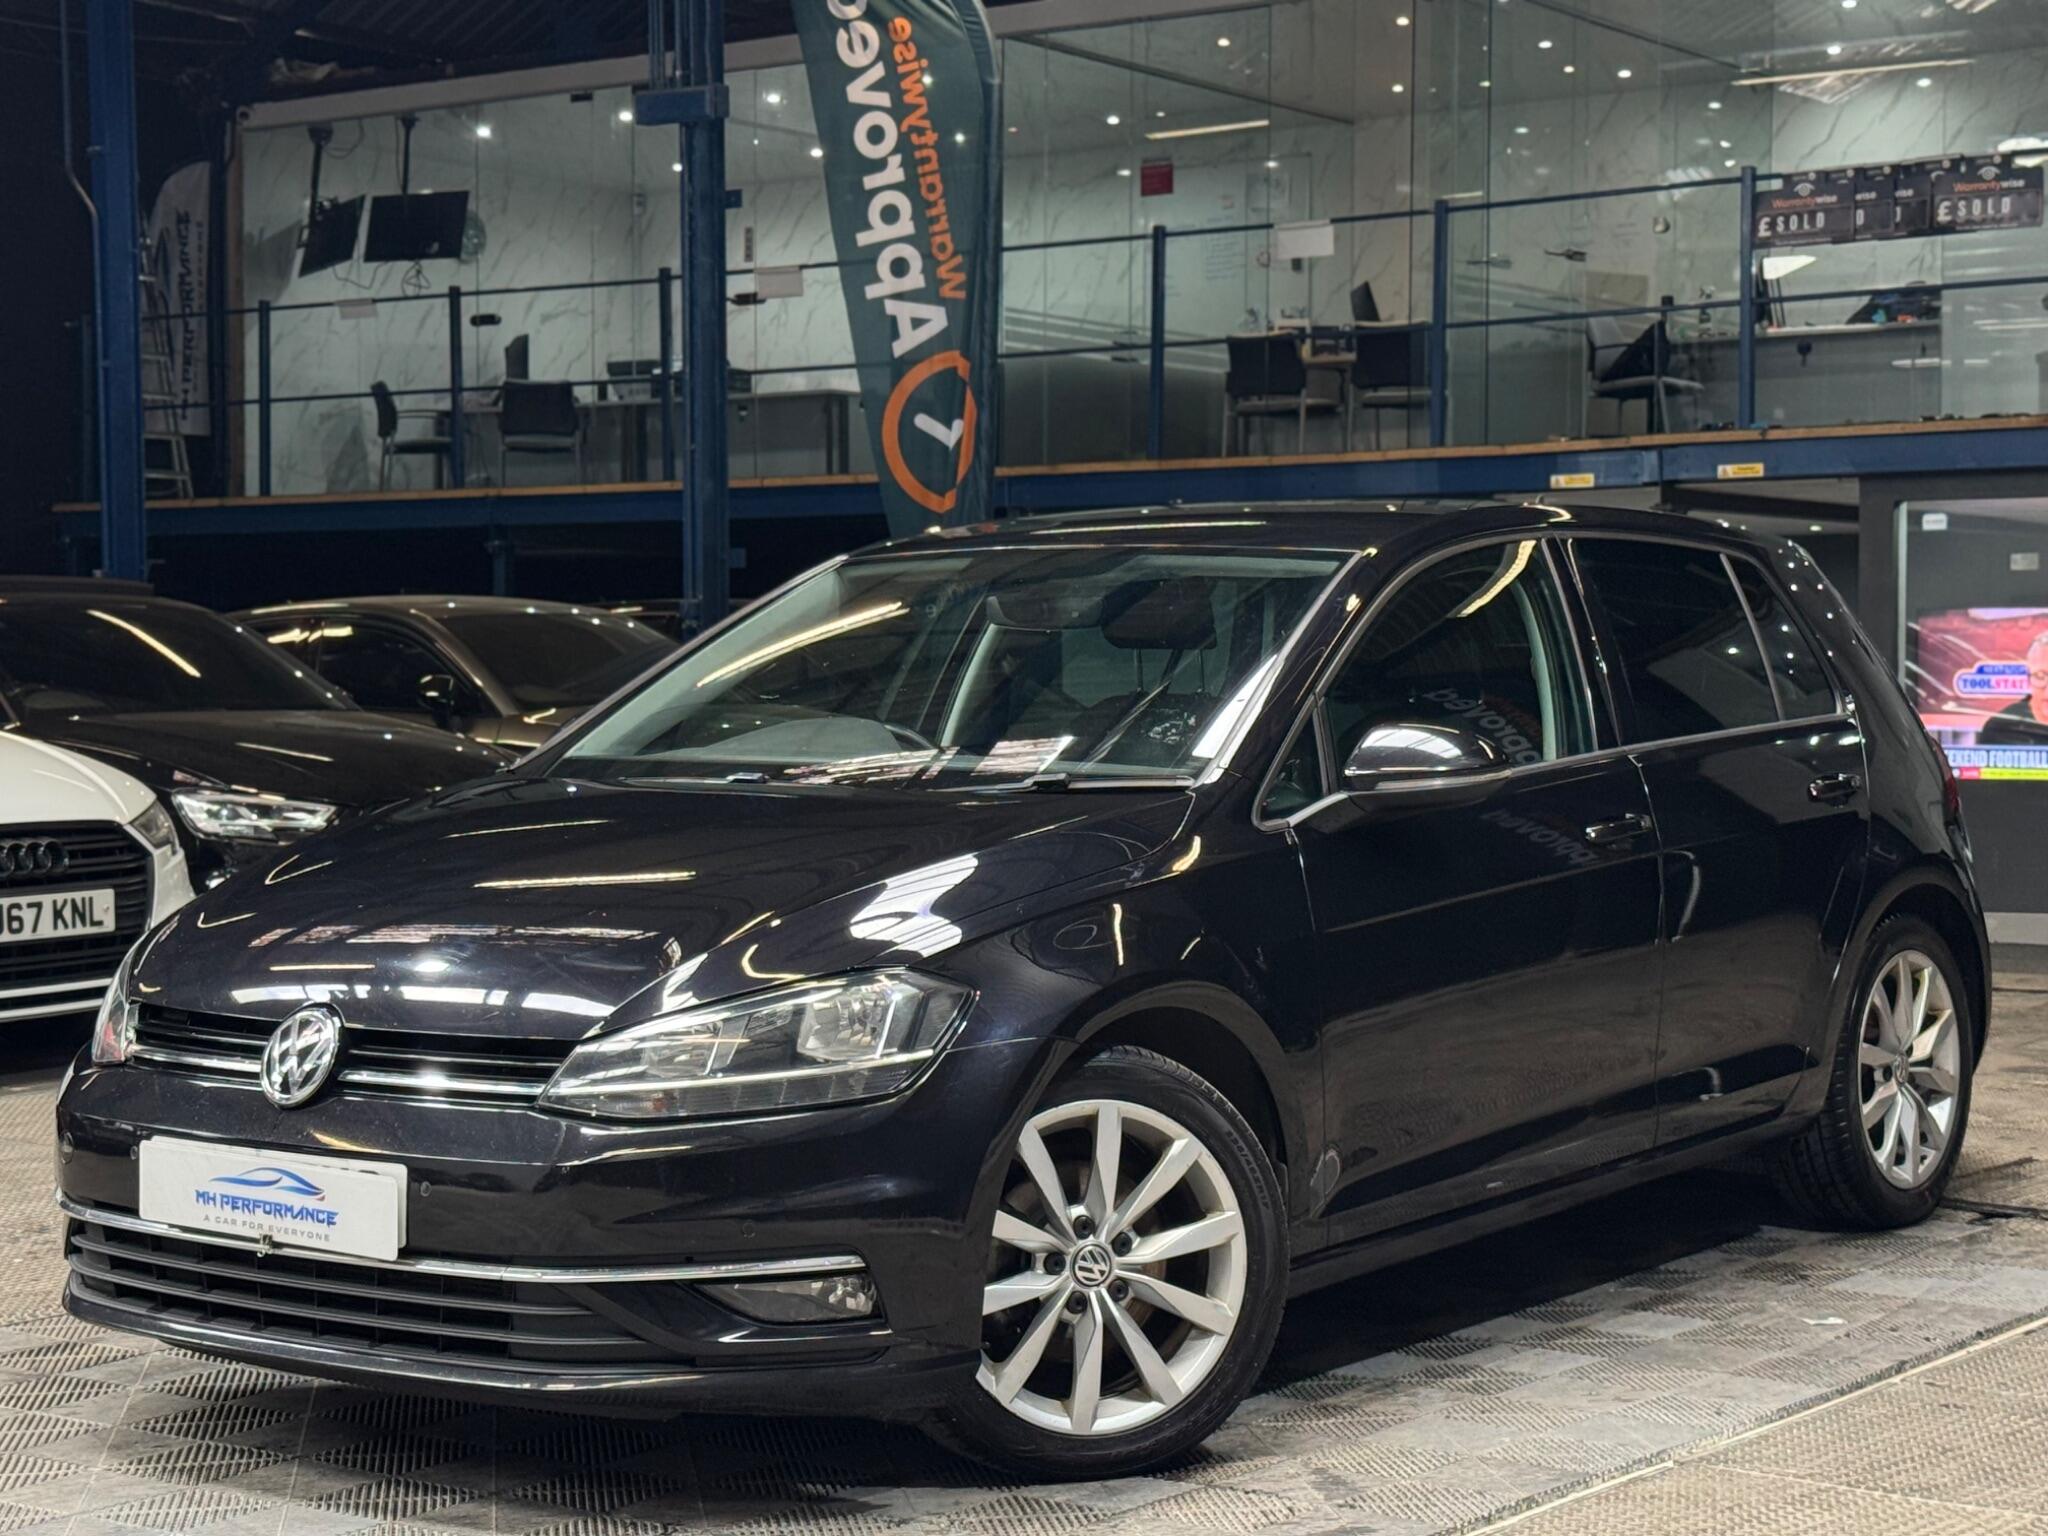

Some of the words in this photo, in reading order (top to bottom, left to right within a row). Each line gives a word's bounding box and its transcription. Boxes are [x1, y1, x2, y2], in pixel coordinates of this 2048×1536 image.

[0, 902, 43, 935] 67
[52, 896, 104, 931] KNL
[195, 1189, 217, 1208] MH
[219, 1193, 339, 1228] PERFORMANCE
[203, 1214, 211, 1222] A
[215, 1216, 238, 1227] CAR
[242, 1220, 264, 1231] FOR
[268, 1225, 331, 1241] EVERYONE
